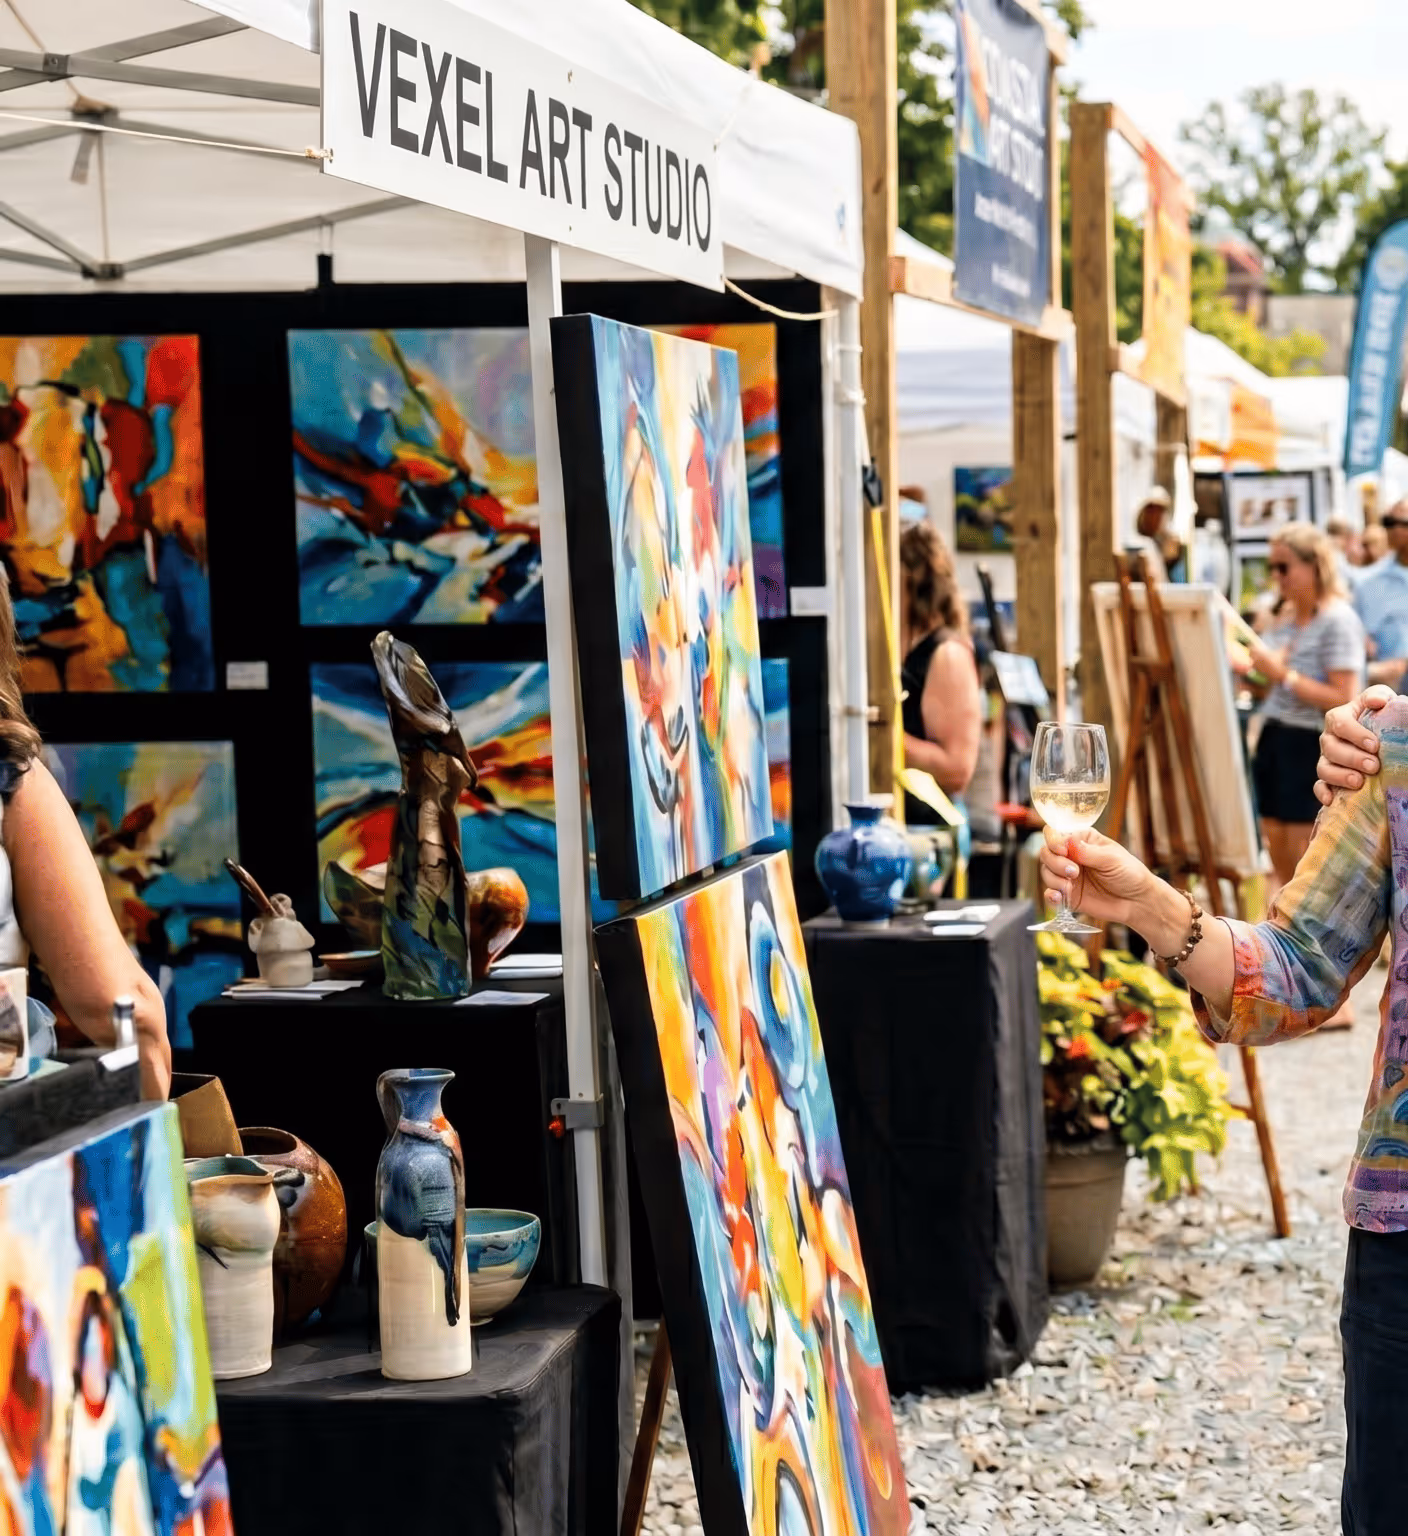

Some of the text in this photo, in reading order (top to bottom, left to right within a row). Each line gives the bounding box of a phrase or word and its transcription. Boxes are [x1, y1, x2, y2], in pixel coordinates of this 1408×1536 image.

[349, 10, 712, 253] VEXEL ART STUDIO
